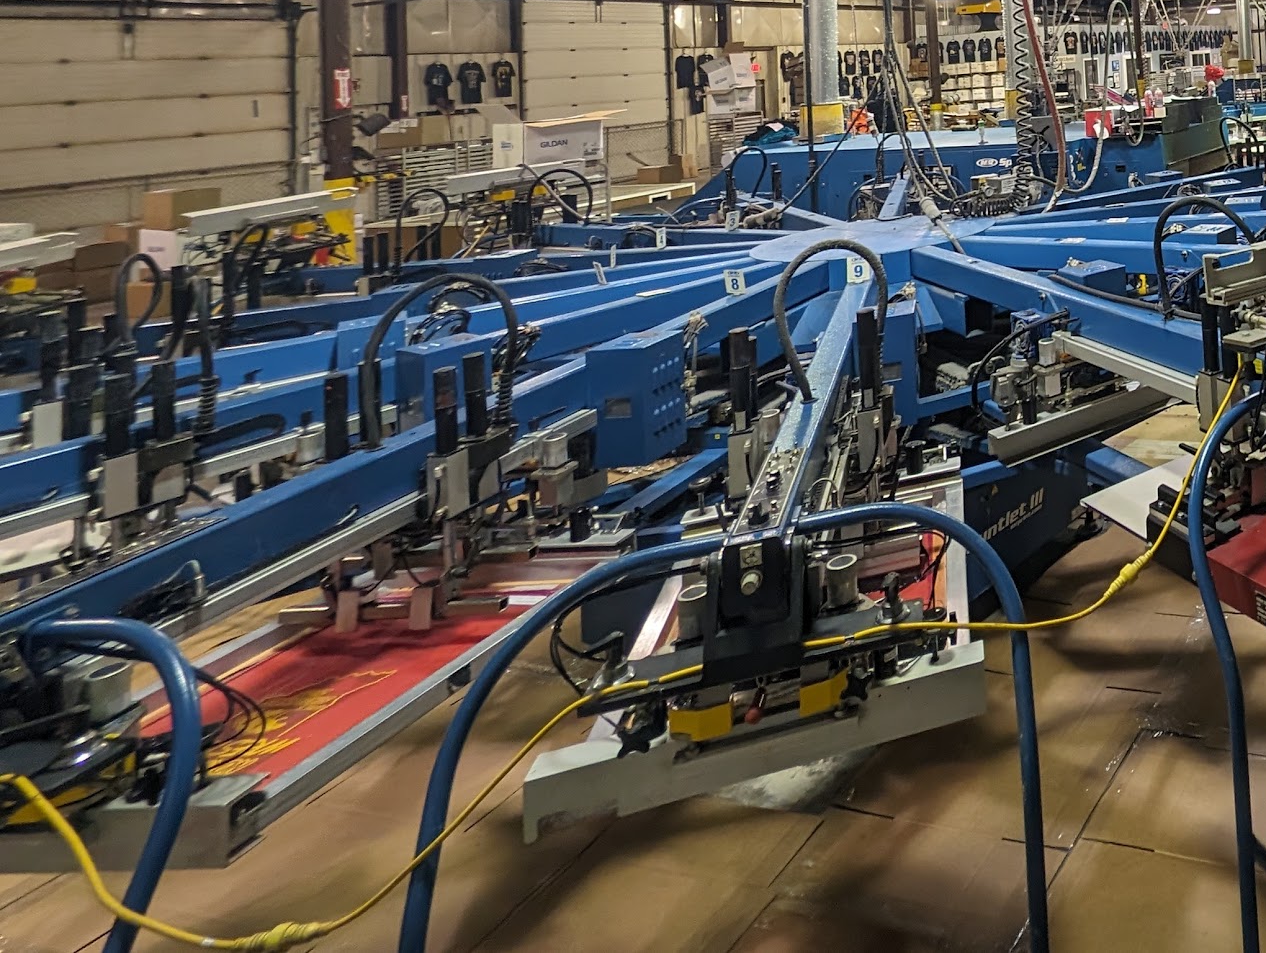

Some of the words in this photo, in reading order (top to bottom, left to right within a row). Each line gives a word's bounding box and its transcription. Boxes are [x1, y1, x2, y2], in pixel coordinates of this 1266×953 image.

[540, 139, 568, 148] GILDAN
[729, 218, 736, 227] 3
[853, 264, 864, 278] 9
[730, 278, 740, 291] 8
[1029, 487, 1044, 510] III
